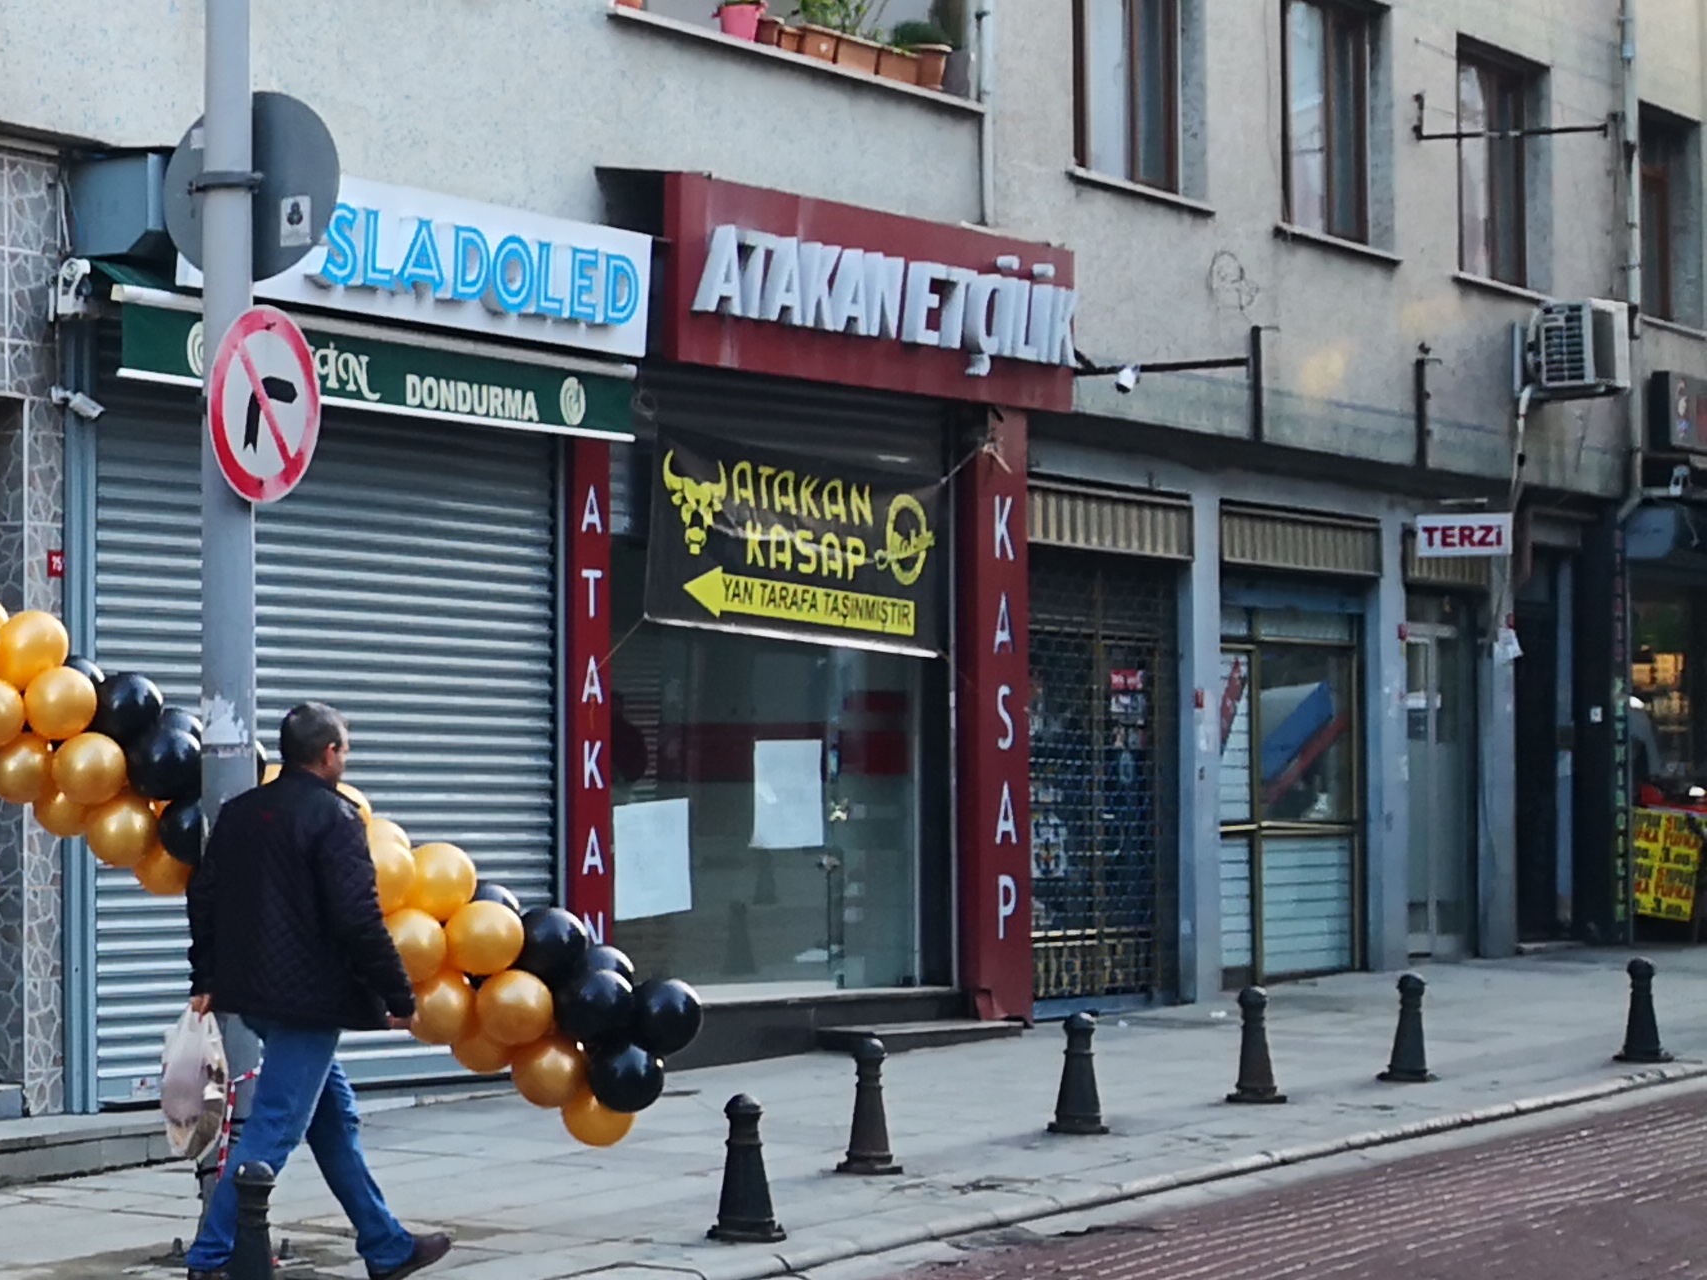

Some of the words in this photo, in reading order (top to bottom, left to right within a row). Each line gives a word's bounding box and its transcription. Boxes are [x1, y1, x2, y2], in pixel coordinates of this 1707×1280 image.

[319, 202, 641, 326] SLADOLED
[405, 373, 540, 423] DONDURMA
[732, 461, 874, 527] ATAKAN
[746, 519, 866, 581] KASAP
[1422, 525, 1504, 548] TERZi
[722, 578, 754, 605] YAN
[759, 583, 818, 613] TARAFA
[993, 494, 1018, 940] KASAP
